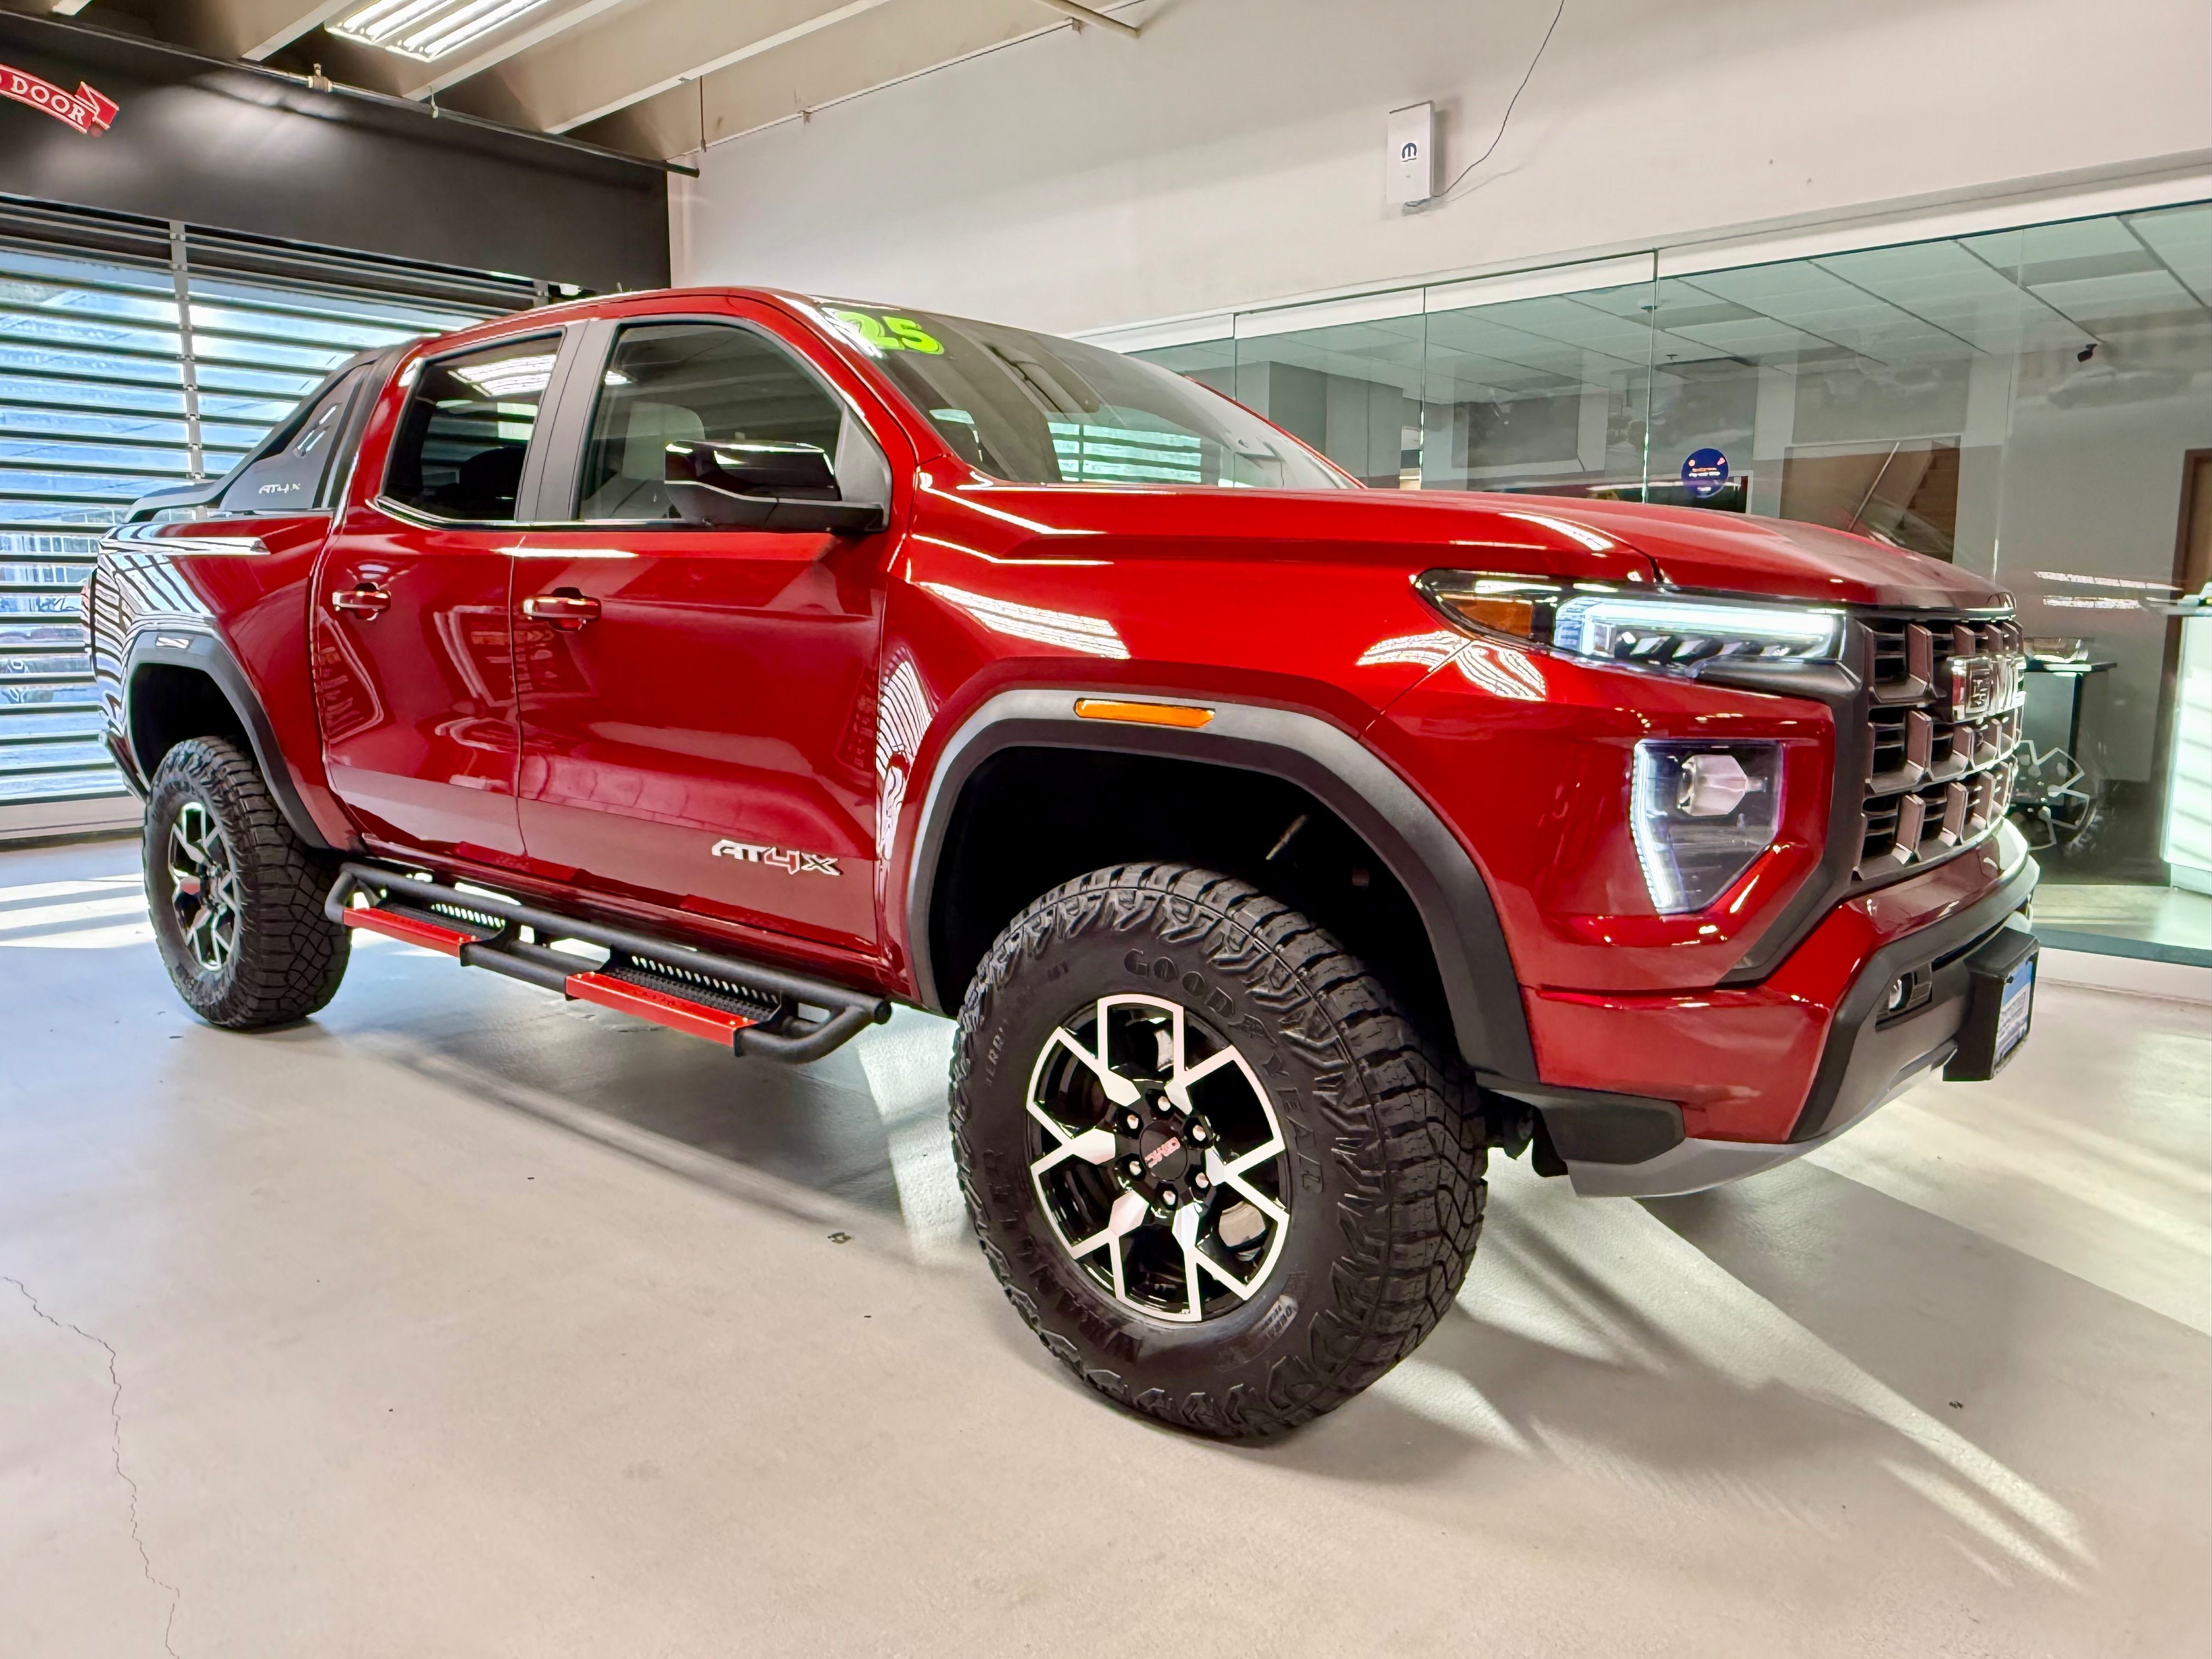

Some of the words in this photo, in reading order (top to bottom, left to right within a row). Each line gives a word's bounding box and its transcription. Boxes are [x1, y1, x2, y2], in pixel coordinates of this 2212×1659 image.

[11, 75, 86, 125] DOOR
[830, 311, 944, 355] 25
[712, 839, 842, 876] AT4X
